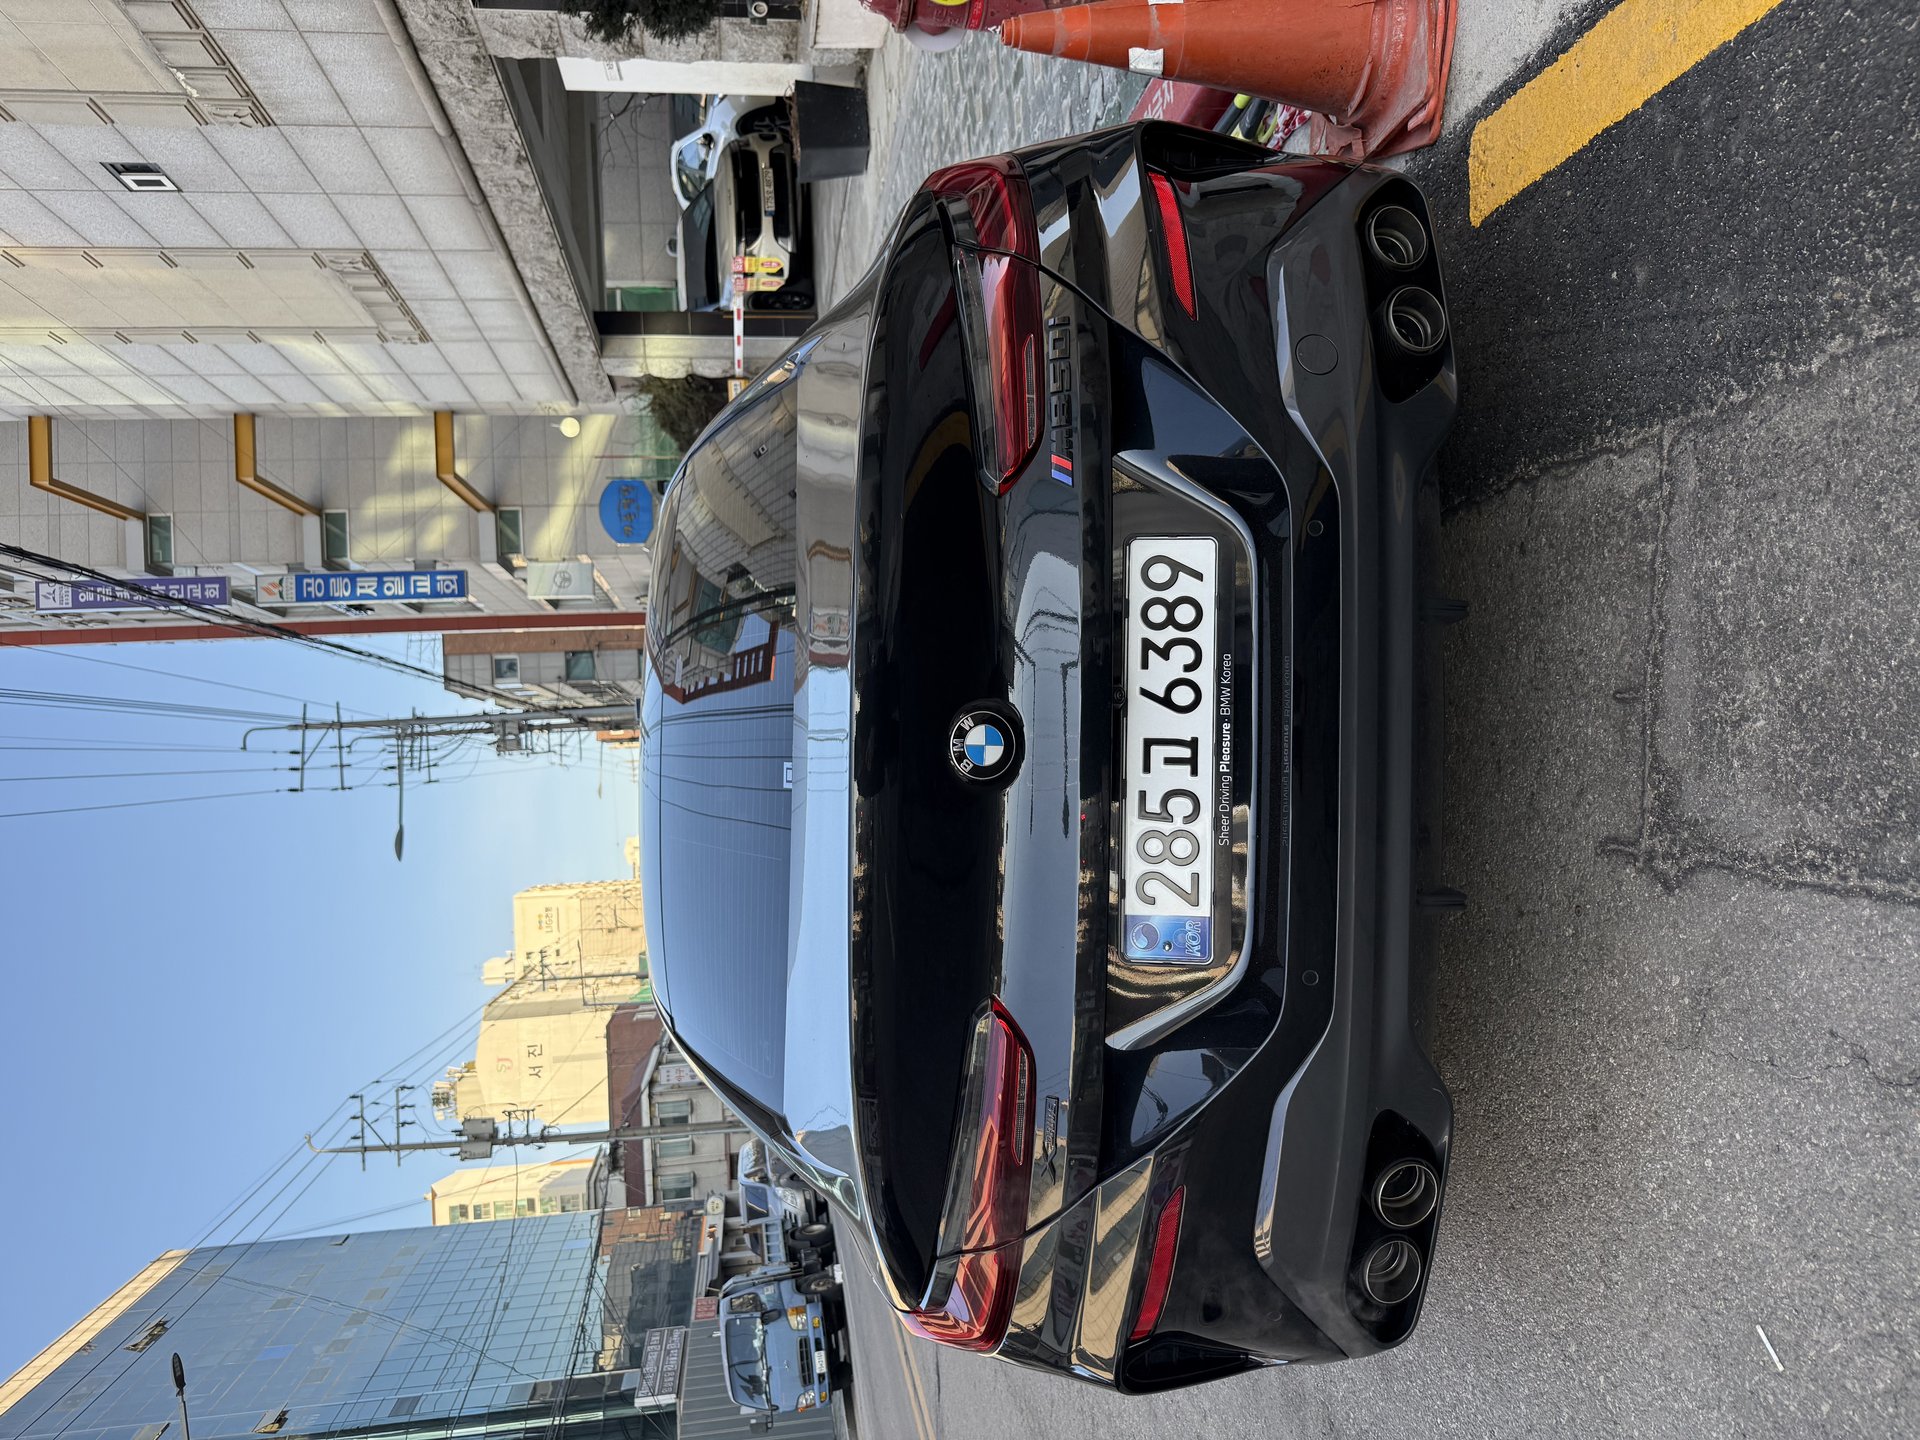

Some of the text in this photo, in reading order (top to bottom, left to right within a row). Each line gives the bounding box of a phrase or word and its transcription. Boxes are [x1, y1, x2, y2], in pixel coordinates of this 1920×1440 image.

[302, 574, 459, 599] 공릉제일교회
[1220, 653, 1231, 683] Korea
[1220, 686, 1231, 715] BMW
[953, 717, 975, 772] BMW
[1135, 554, 1204, 907] 285고 6389
[1219, 775, 1232, 812] Driving
[1219, 815, 1230, 846] Sheer
[1185, 920, 1201, 956] KOR
[527, 1043, 544, 1079] 서진
